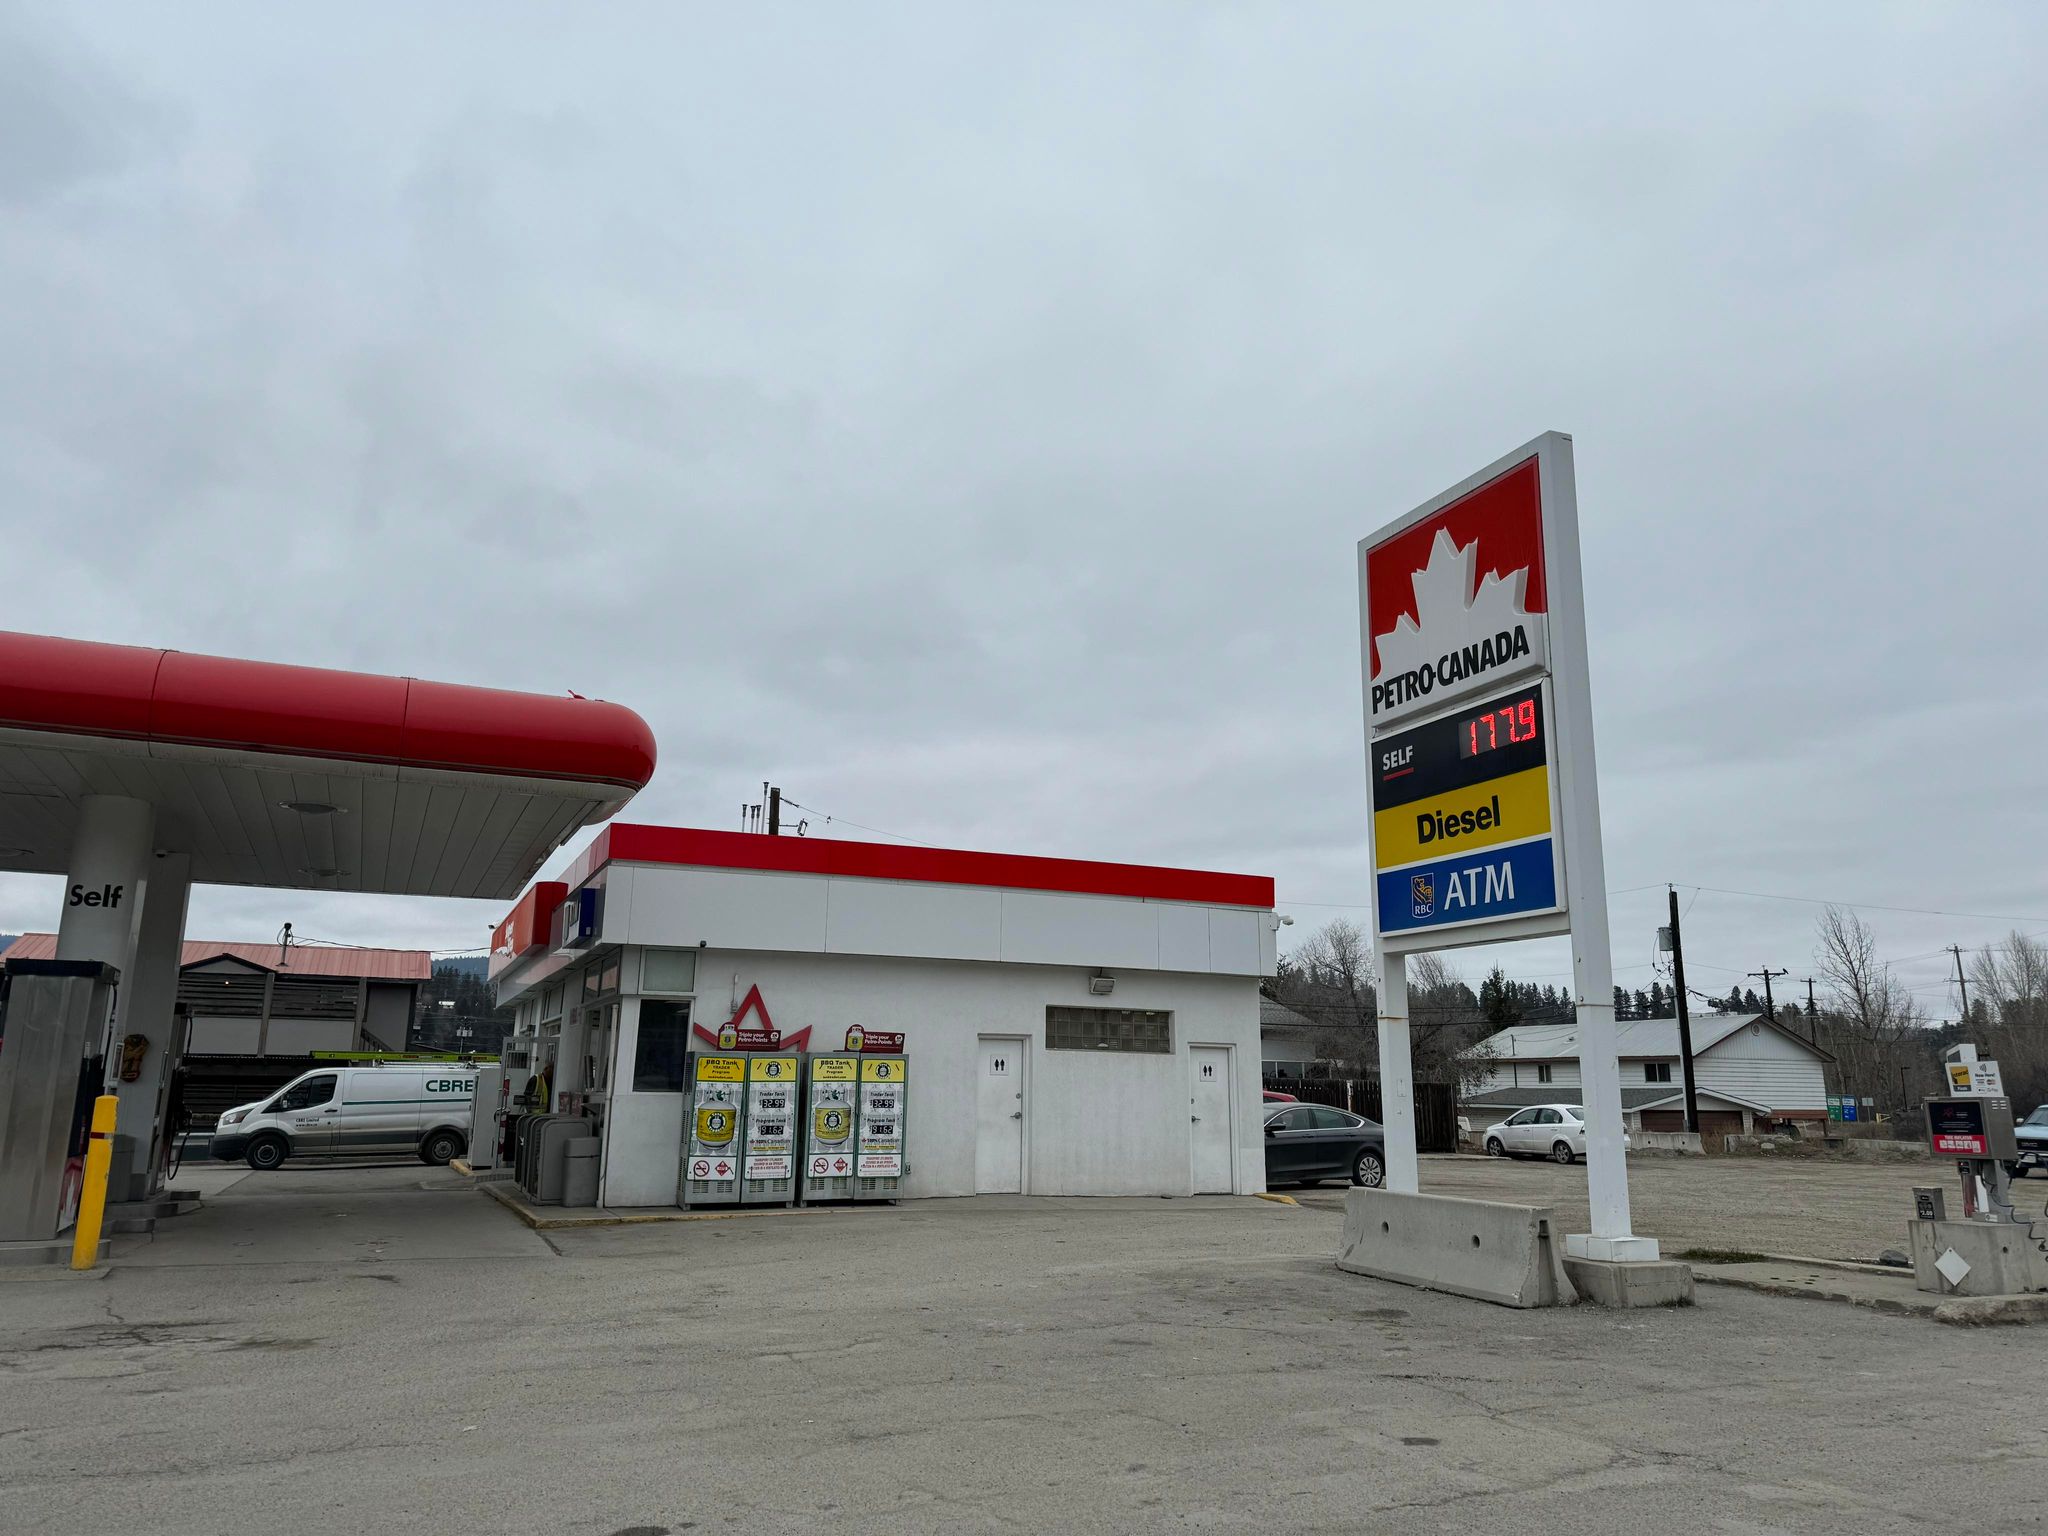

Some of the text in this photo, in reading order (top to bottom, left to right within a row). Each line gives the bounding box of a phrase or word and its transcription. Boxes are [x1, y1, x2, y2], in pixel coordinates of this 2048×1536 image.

[1372, 625, 1530, 715] PETRO-CANADA
[1382, 700, 1537, 771] SELF 177.9
[1417, 795, 1501, 844] Diesel
[69, 884, 124, 908] Self
[1415, 861, 1515, 915] RBC ATM
[753, 1032, 765, 1040] your
[425, 1080, 473, 1092] CBRE
